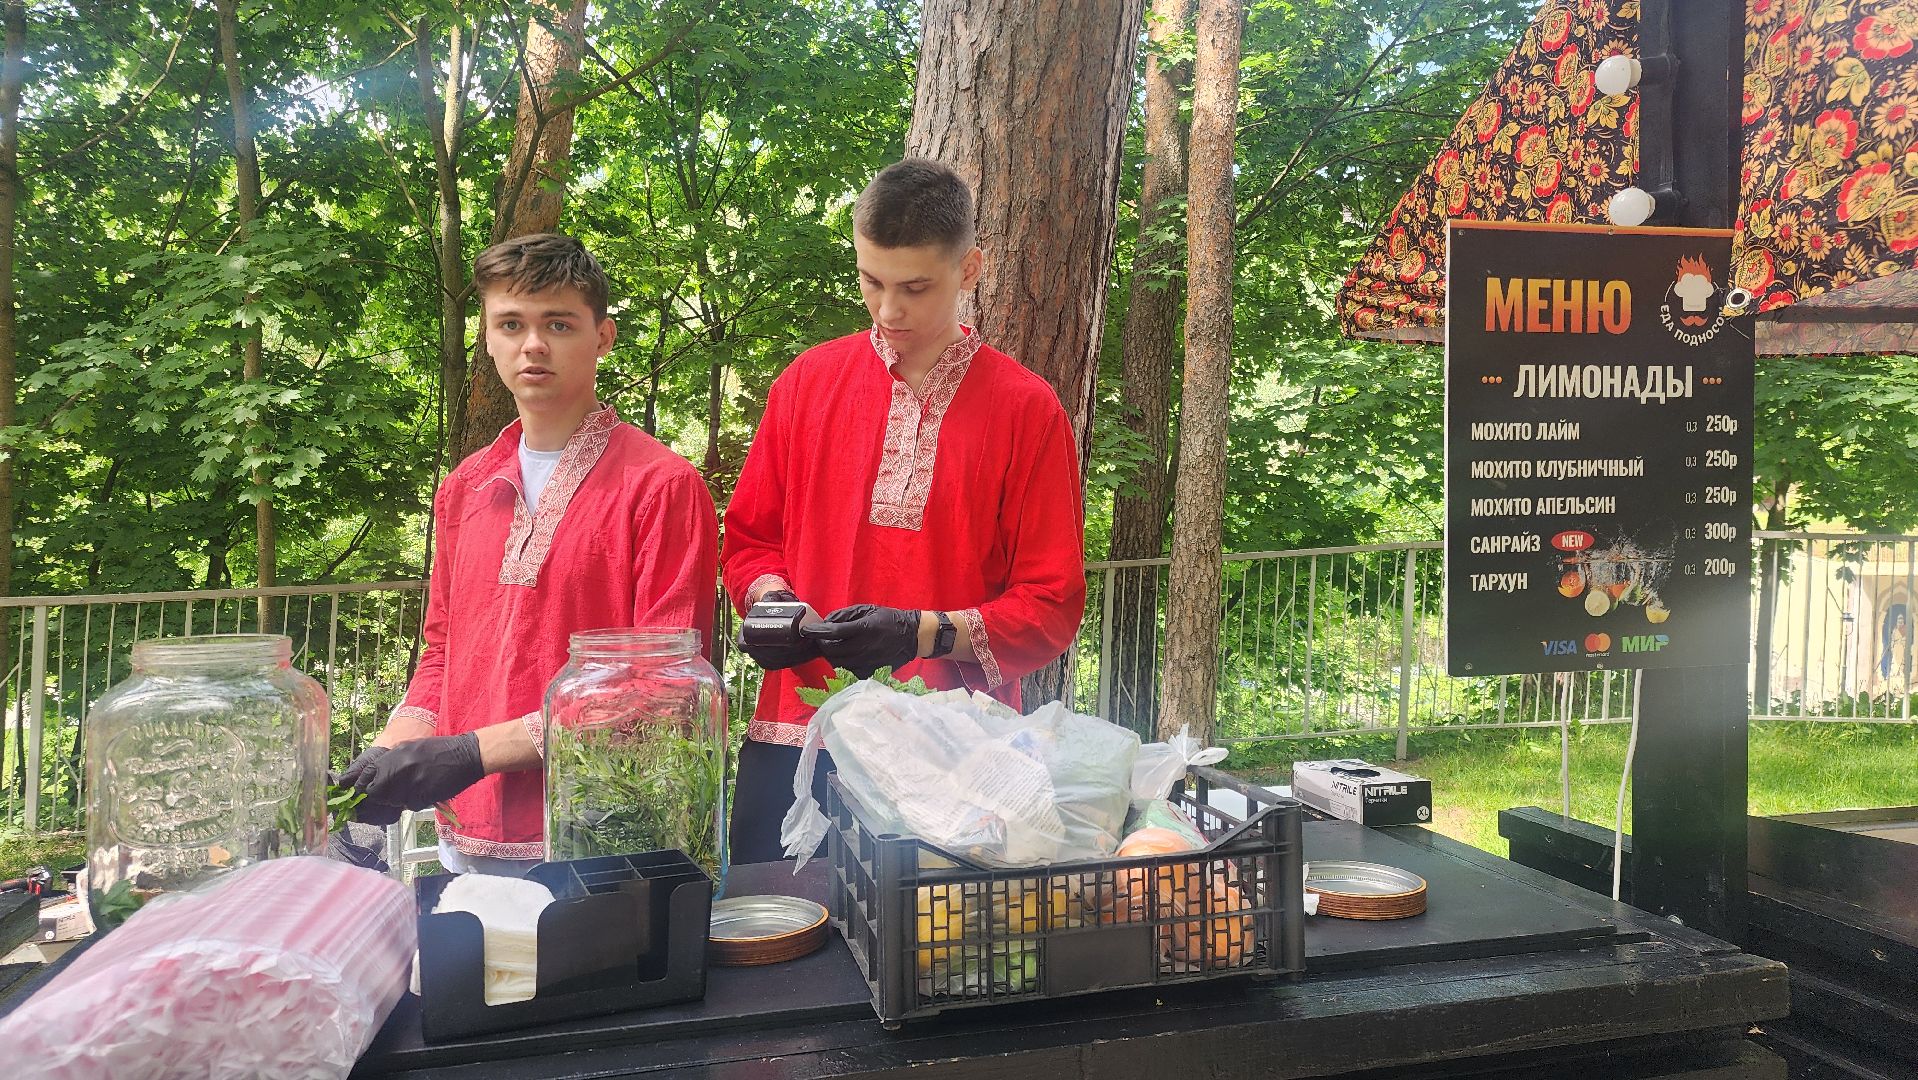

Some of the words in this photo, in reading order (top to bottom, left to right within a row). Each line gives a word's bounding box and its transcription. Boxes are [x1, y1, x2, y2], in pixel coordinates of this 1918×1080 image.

[1485, 277, 1632, 334] МЕНЮ
[1660, 304, 1675, 332] ЕДА
[1513, 364, 1694, 404] ЛИМОНАДЫ
[1471, 423, 1532, 440] МОХИТО
[1536, 419, 1580, 440] ЛАЙМ
[1705, 415, 1738, 435] 250р
[1471, 460, 1532, 479] МОХИТО
[1536, 456, 1644, 480] КЛУБНИЧНЫЙ
[1705, 450, 1738, 470] 250р
[1471, 498, 1532, 517] МОХИТО
[1536, 496, 1616, 515] АПЕЛЬСИН
[1705, 486, 1737, 506] 250р
[1470, 531, 1541, 554] САНРАЙЗ
[1561, 534, 1584, 548] NEW
[1704, 522, 1737, 543] 300р
[1704, 557, 1736, 578] 200р
[1470, 572, 1528, 594] ТАРХУН
[1540, 640, 1578, 656] VISA
[1622, 634, 1670, 653] МИР
[1331, 780, 1358, 796] NITRILE
[1364, 785, 1408, 798] NITRILE
[1418, 808, 1429, 817] XL
